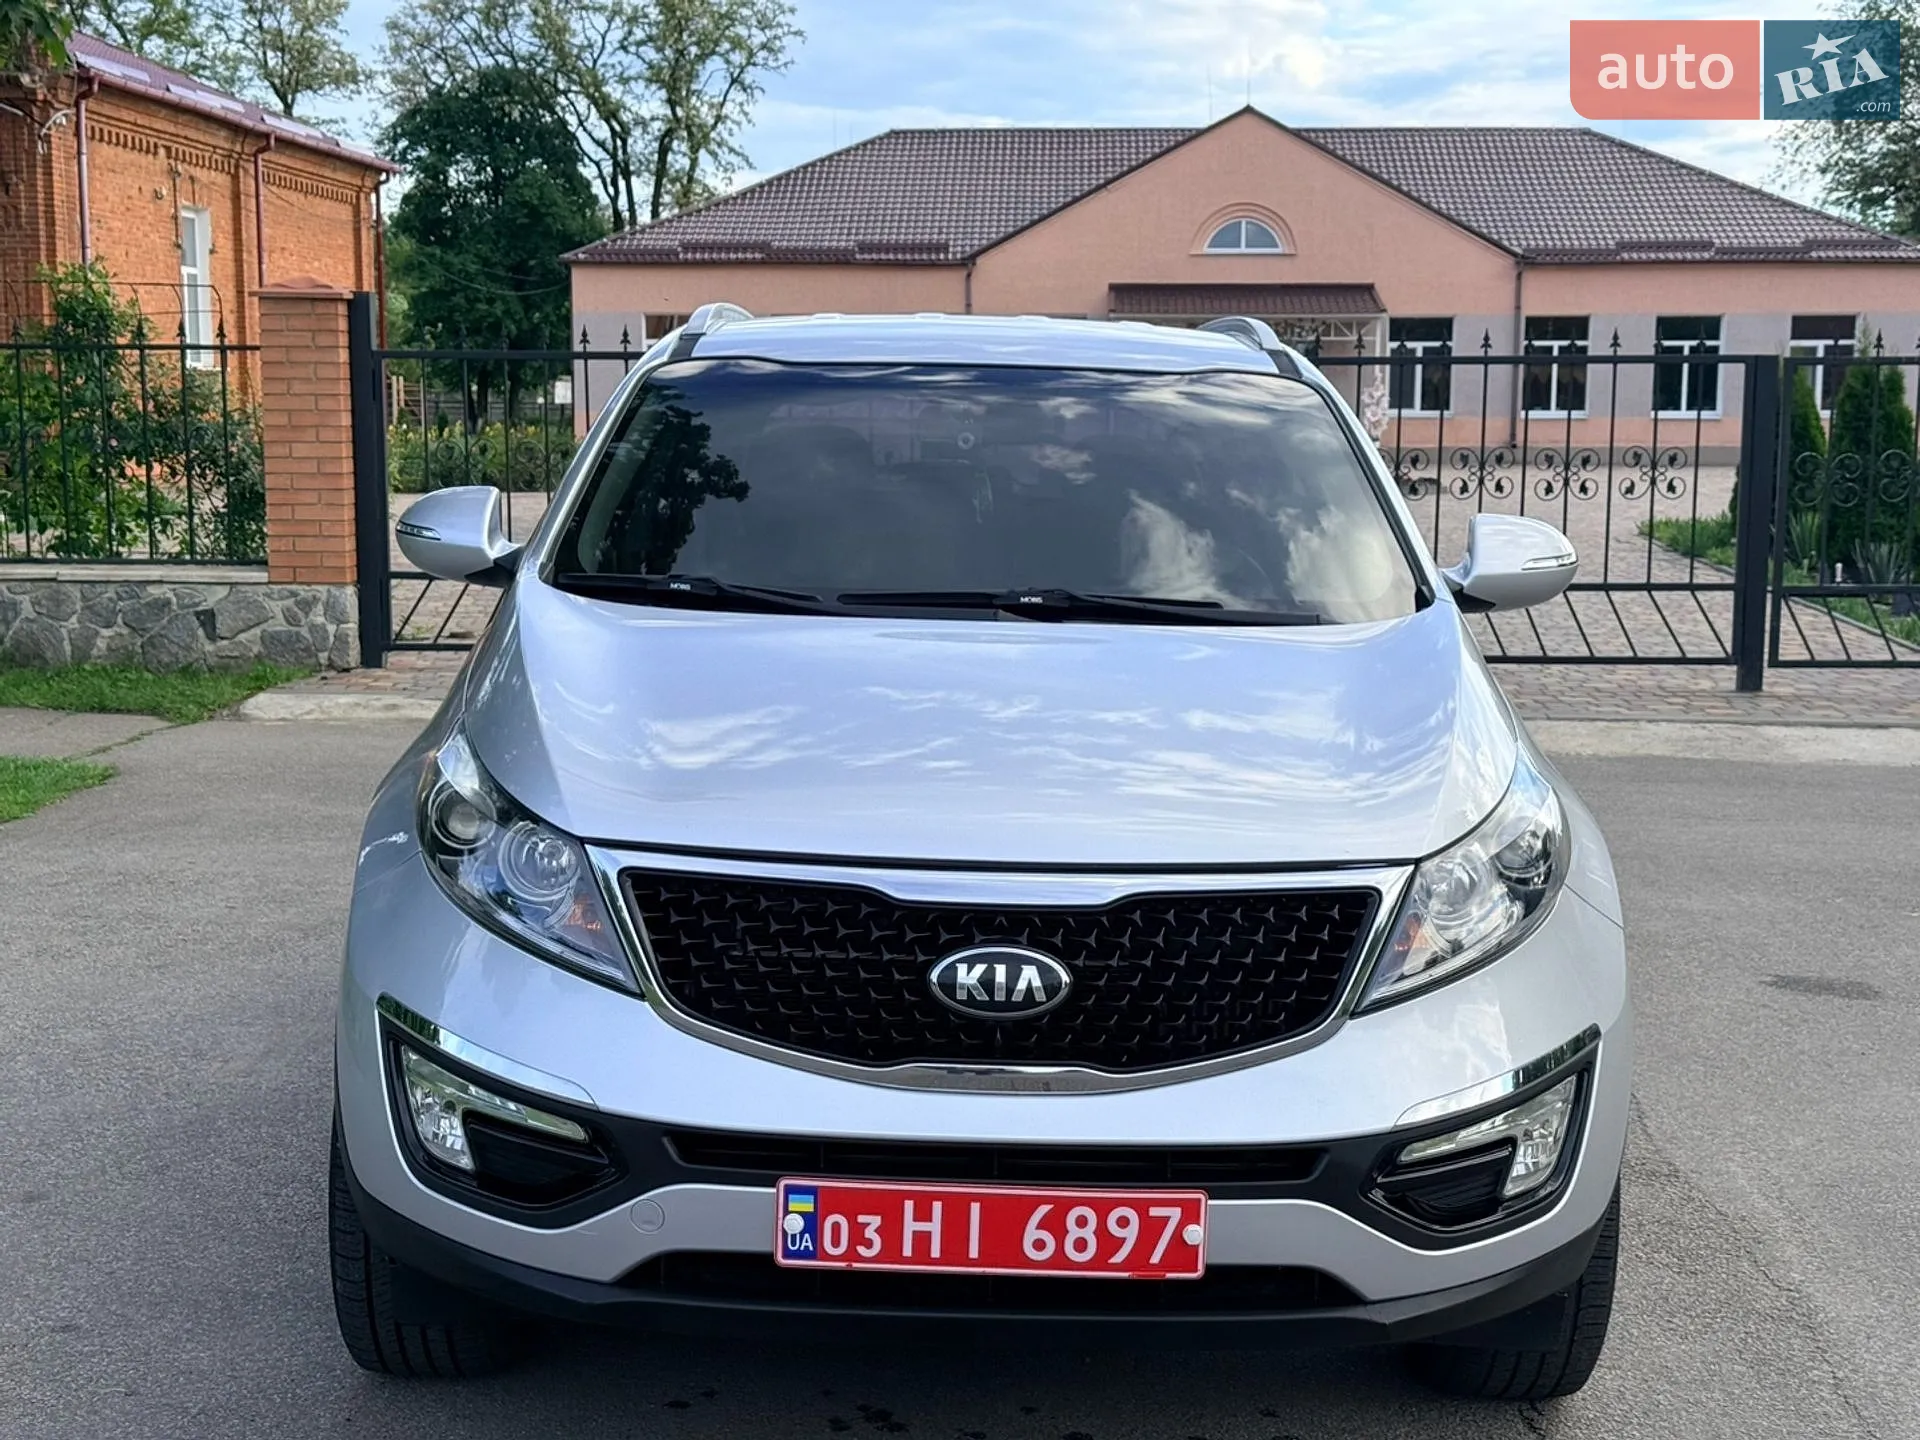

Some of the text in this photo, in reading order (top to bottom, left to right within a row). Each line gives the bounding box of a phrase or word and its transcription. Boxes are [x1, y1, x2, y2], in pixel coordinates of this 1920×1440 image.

[955, 963, 1047, 1002] KIA
[787, 1232, 814, 1251] UA
[822, 1213, 882, 1258] 03
[1021, 1203, 1182, 1265] 6897
